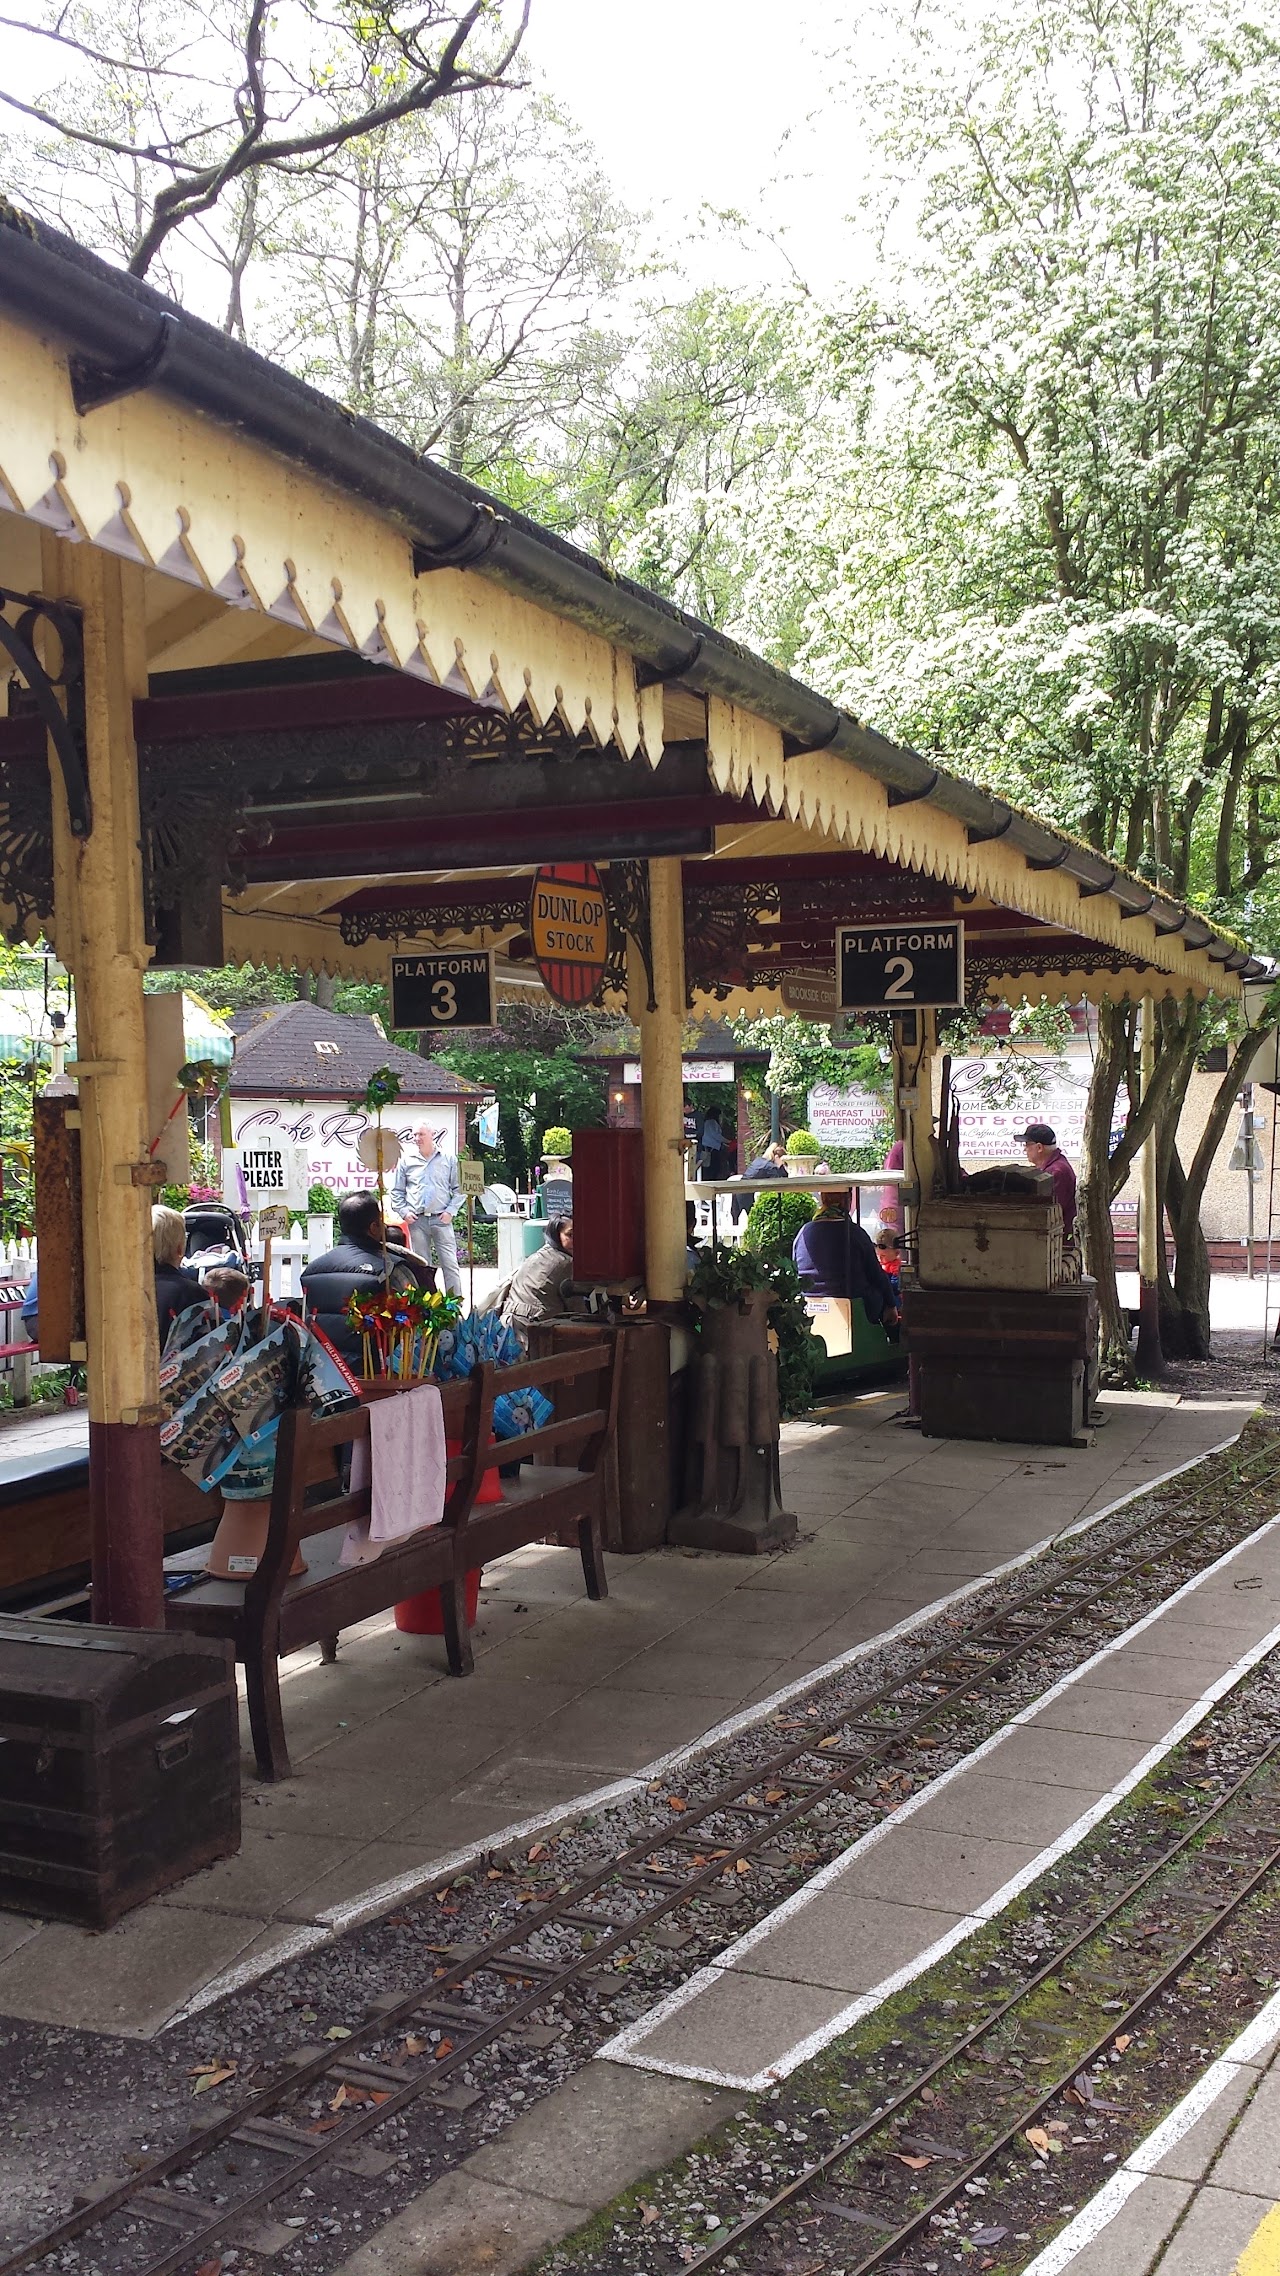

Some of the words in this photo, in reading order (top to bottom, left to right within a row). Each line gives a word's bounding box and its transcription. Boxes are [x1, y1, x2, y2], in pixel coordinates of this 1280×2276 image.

[537, 893, 604, 927] DUNLOP
[546, 930, 595, 953] STOCK
[845, 934, 953, 954] PLATFORM
[394, 959, 487, 977] PLATFORM
[884, 956, 915, 1000] 2
[430, 980, 458, 1020] 3
[788, 986, 819, 1001] BROOKSIDE
[820, 990, 837, 1003] CENT
[813, 1109, 864, 1117] BREAKFAST
[1044, 1101, 1083, 1110] FRESH
[820, 1118, 874, 1126] AFTERNOON
[1013, 1115, 1062, 1126] COLD
[243, 1150, 283, 1169] LITTER
[242, 1169, 284, 1188] PLEASE
[323, 1342, 336, 1357] FULL
[331, 1353, 347, 1372] STEAM
[343, 1370, 361, 1394] AHEAD!
